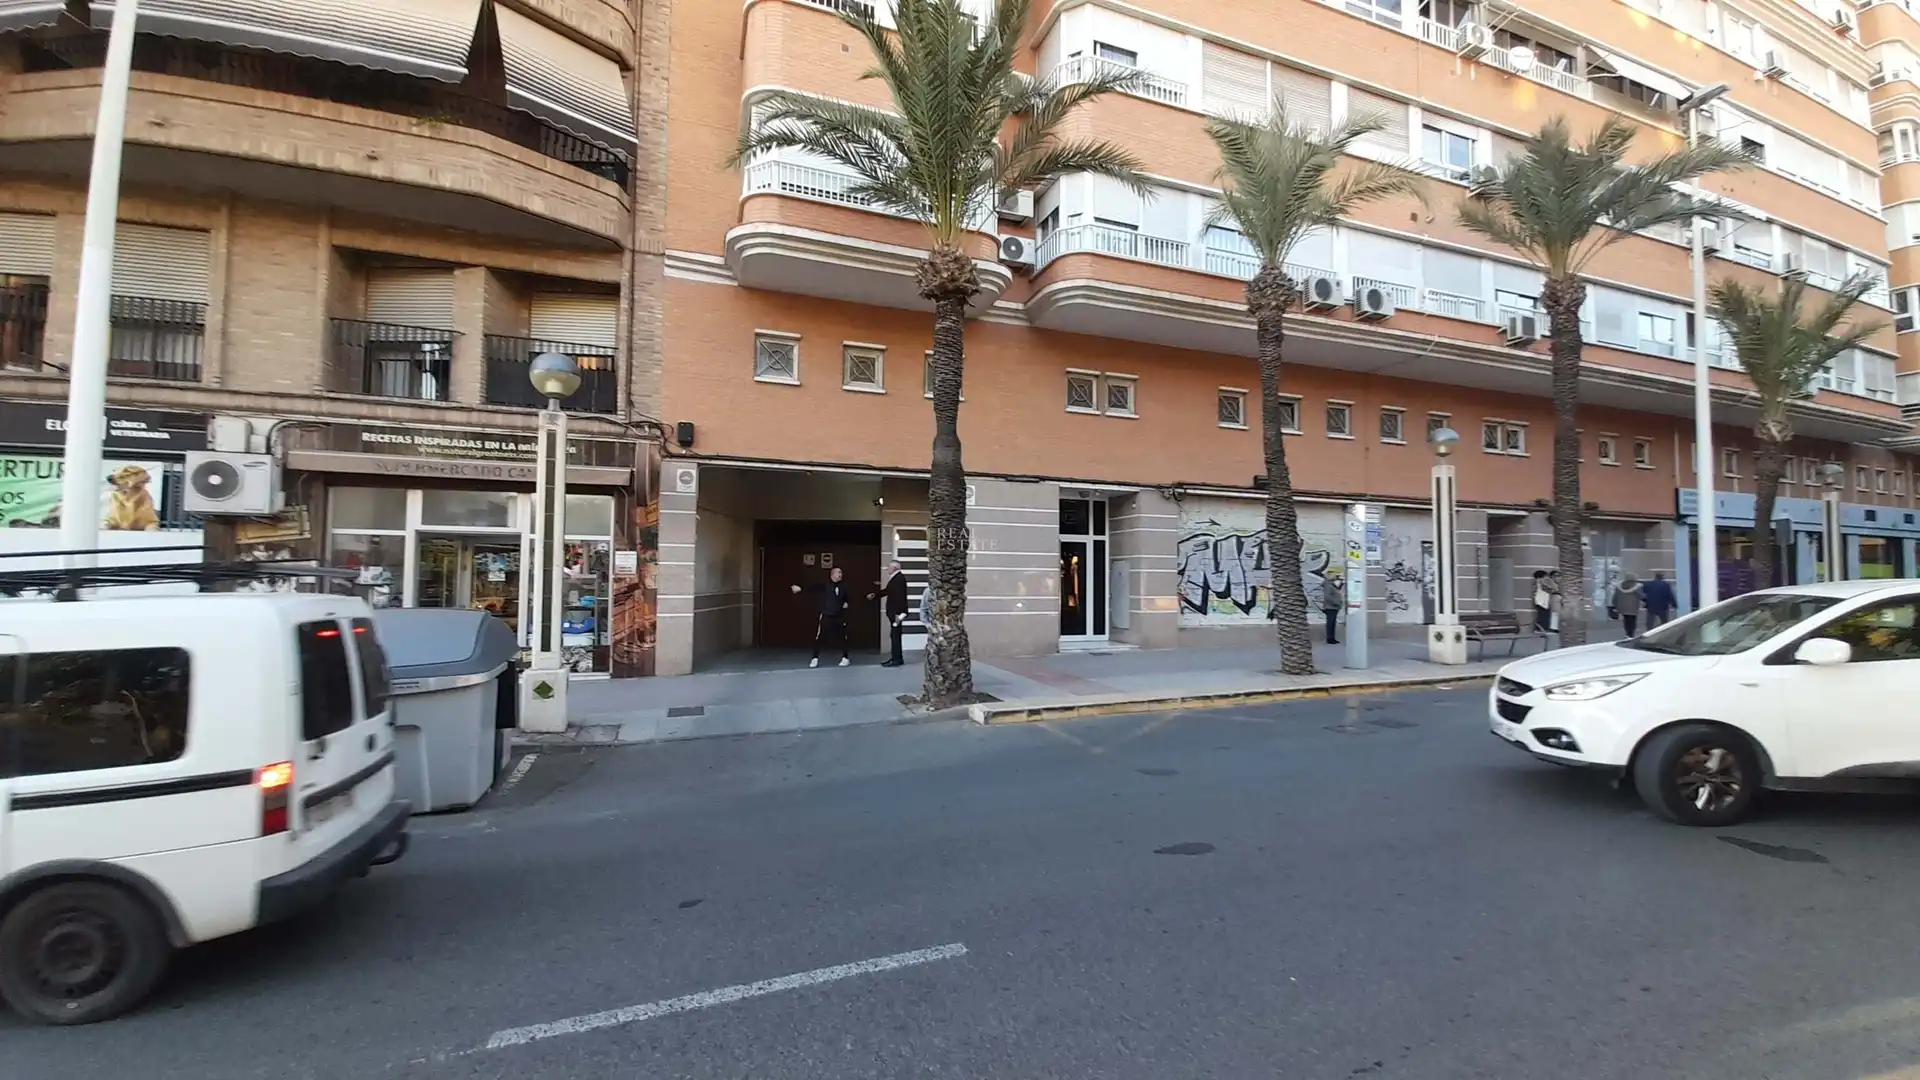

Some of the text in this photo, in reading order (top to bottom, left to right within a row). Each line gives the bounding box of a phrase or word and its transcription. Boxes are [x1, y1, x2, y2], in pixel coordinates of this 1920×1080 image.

[361, 432, 413, 444] RECETAS
[414, 435, 483, 449] INSPIRADAS
[484, 441, 500, 450] EN
[501, 442, 517, 451] LA
